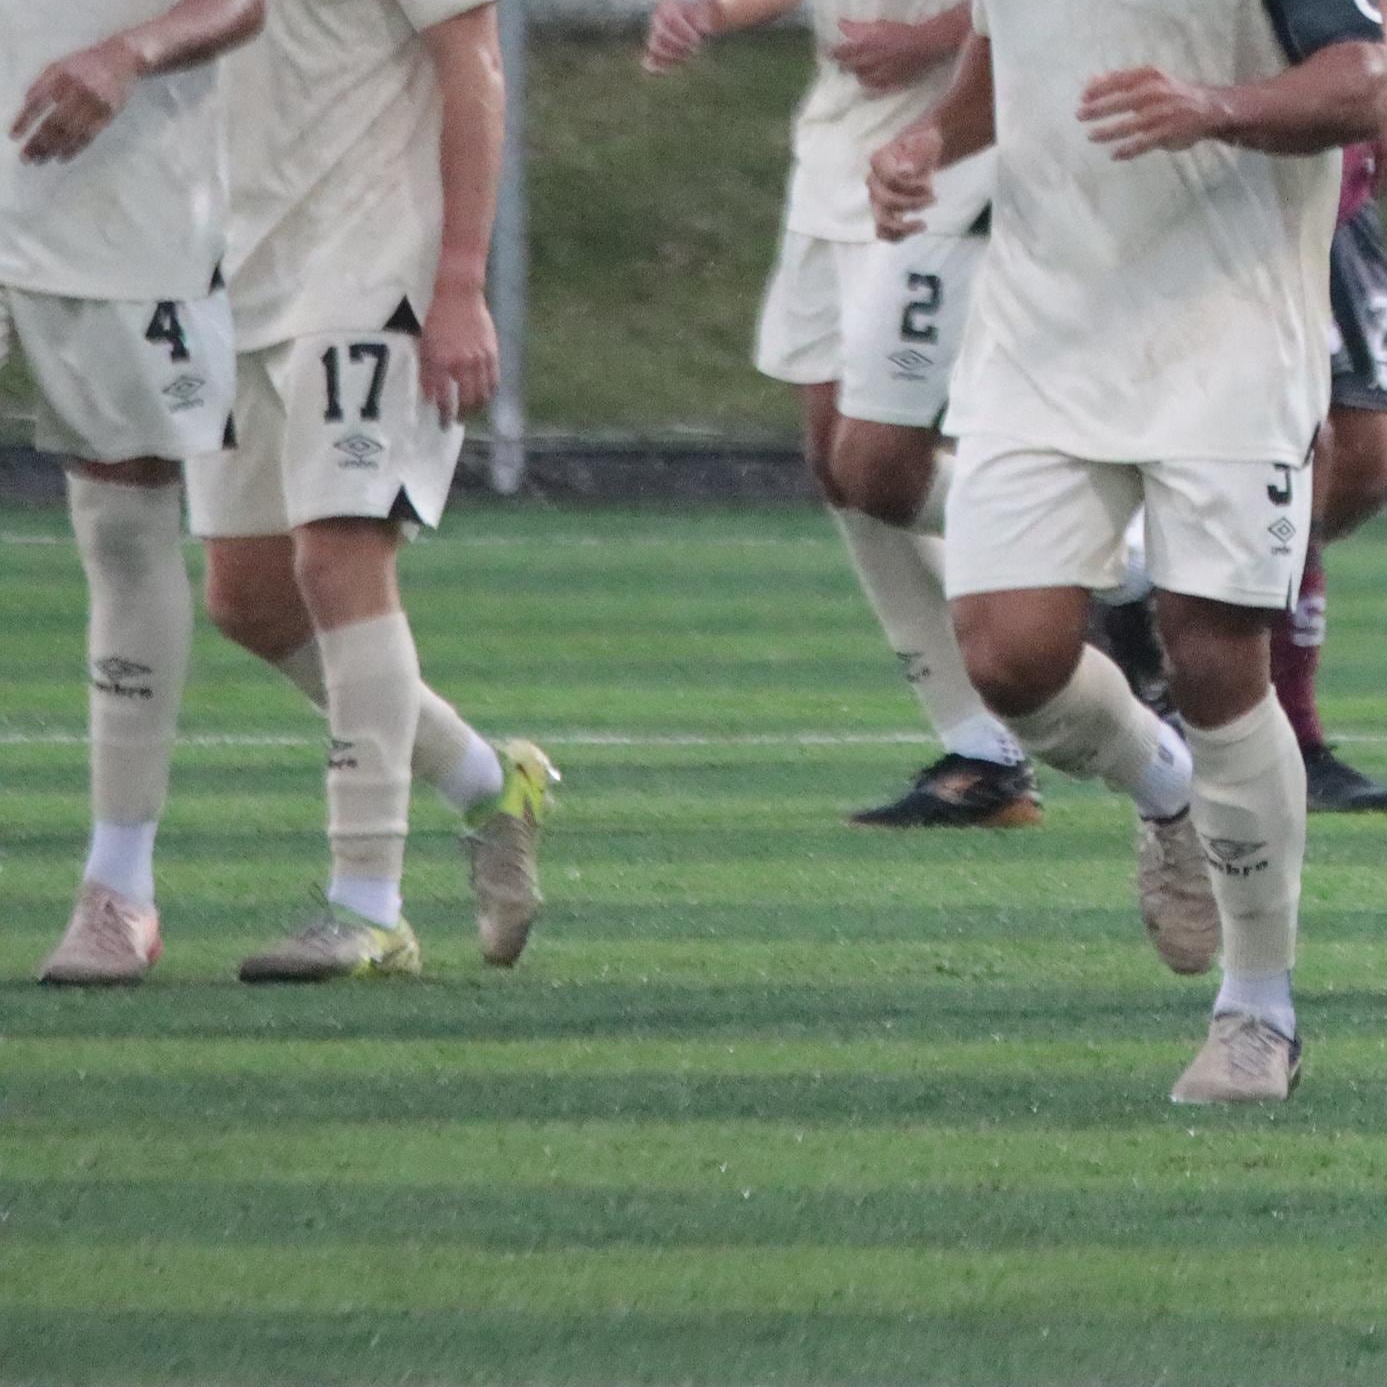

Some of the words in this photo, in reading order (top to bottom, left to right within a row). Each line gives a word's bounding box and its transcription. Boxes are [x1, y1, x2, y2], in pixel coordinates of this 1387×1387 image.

[144, 300, 190, 365] 4
[900, 271, 943, 344] 2
[321, 342, 389, 422] 17
